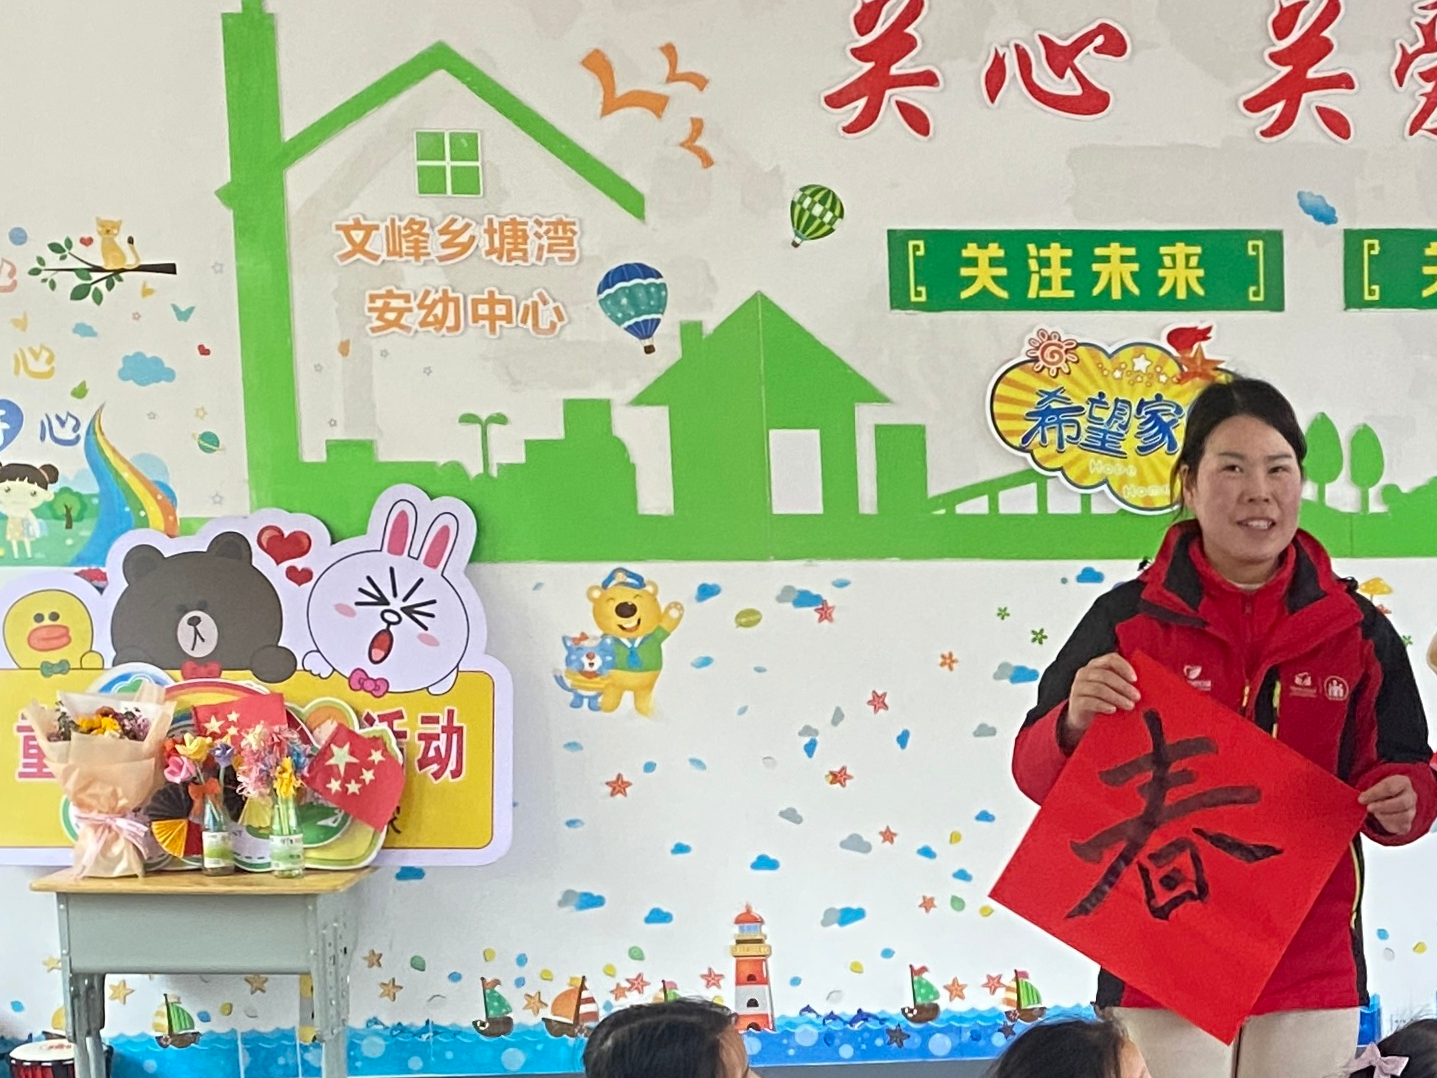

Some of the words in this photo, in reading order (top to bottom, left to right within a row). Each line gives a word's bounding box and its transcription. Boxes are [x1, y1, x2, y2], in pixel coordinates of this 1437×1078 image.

[824, 0, 1129, 137] 关心
[334, 216, 580, 263] 文峰乡塘湾
[959, 242, 1205, 299] 关注未来
[366, 289, 567, 335] 安幼中心
[1065, 709, 1284, 921] 春
